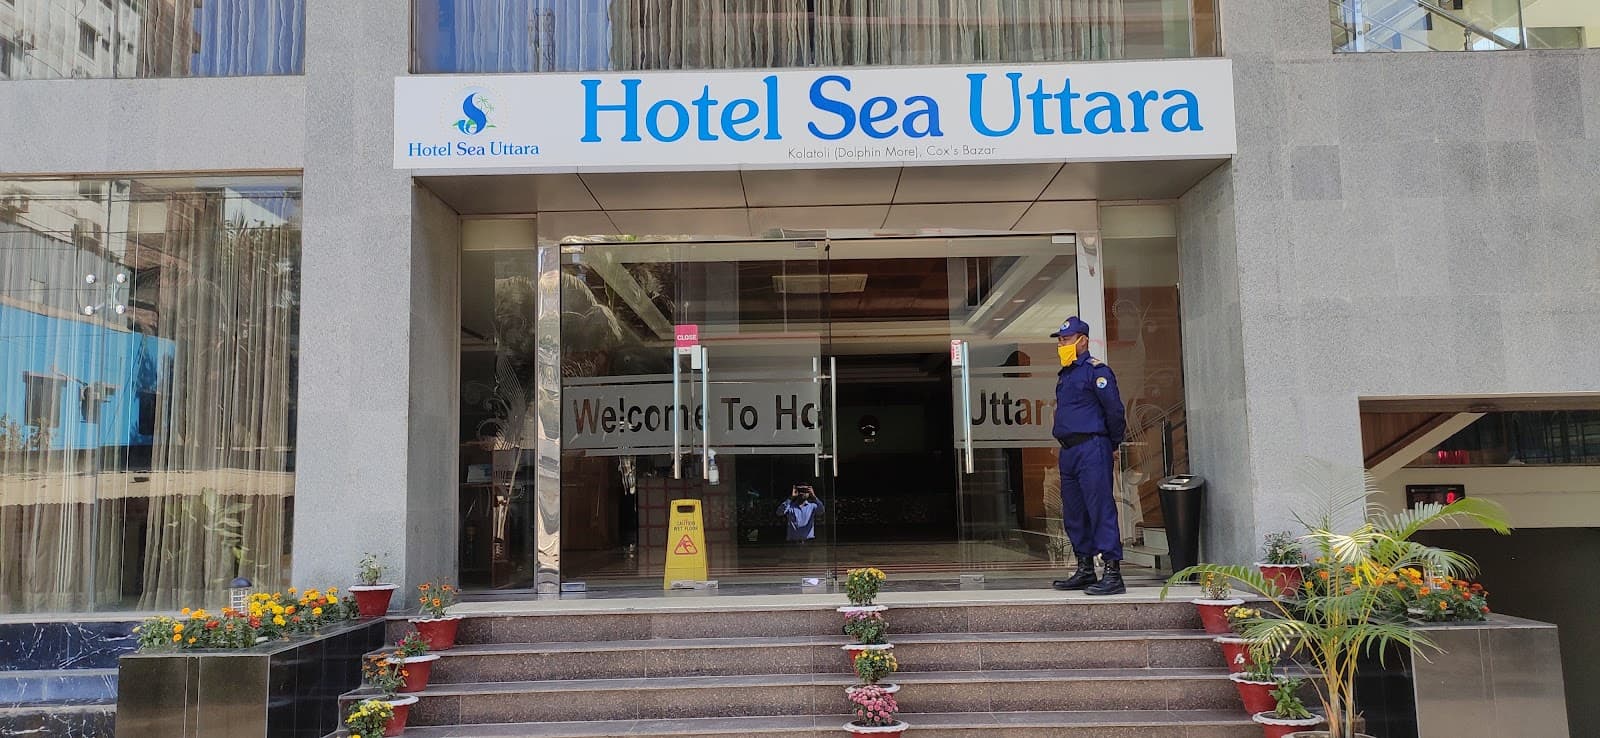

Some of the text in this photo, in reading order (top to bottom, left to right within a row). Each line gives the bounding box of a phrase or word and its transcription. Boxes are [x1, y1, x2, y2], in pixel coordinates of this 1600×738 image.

[580, 72, 1204, 143] Hotel Sea Uttara
[408, 141, 540, 156] Hotel Sea Uttara
[835, 146, 880, 160] (Dolphin
[927, 145, 959, 156] Cox's
[962, 144, 996, 155] Bazar
[573, 398, 708, 434] Welcome
[720, 397, 758, 431] To
